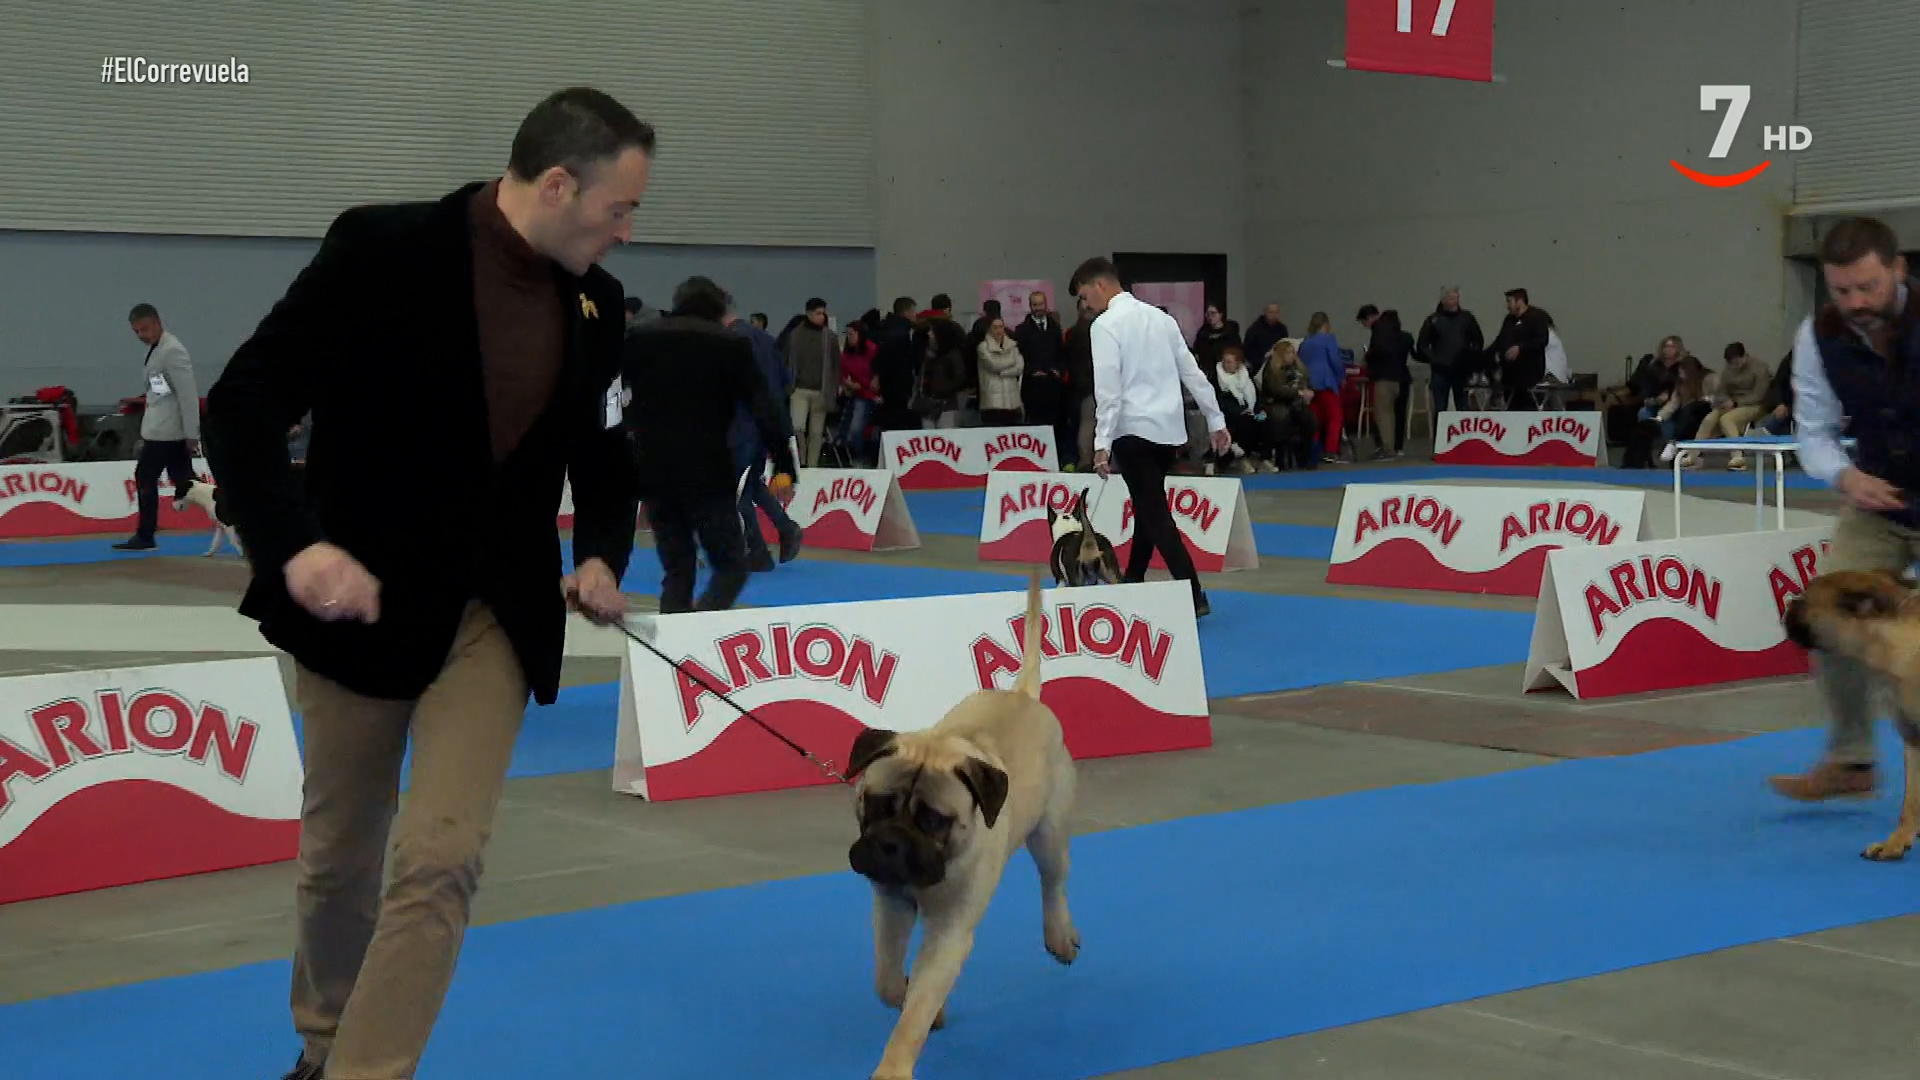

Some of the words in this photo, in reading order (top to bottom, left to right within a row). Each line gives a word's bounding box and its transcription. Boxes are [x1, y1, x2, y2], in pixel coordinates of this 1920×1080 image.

[896, 433, 962, 465] ARION
[984, 432, 1047, 463] ARION
[1446, 417, 1507, 443] ARION
[1527, 417, 1590, 443] ARION
[811, 476, 877, 516] ARION
[1121, 486, 1221, 533] AION
[1354, 494, 1462, 547] ARION
[1499, 498, 1621, 553] ARION
[1583, 554, 1724, 641] ARION
[672, 622, 901, 734] ARION
[968, 602, 1174, 692] ARION
